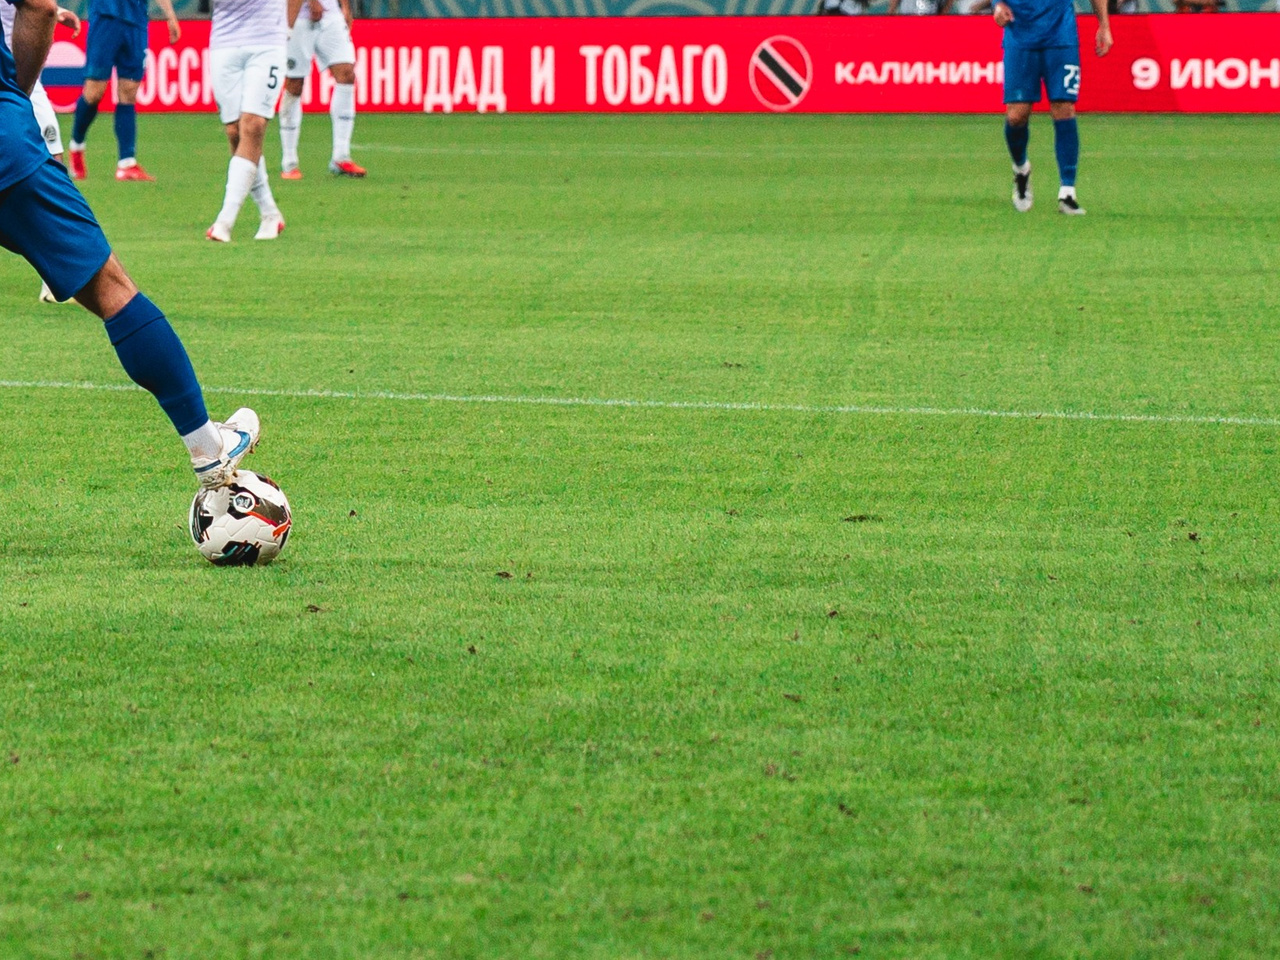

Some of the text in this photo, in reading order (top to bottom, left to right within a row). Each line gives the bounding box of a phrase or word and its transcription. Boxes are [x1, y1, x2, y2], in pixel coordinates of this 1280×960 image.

[267, 65, 279, 90] 5
[530, 45, 555, 105] И
[579, 43, 728, 106] ТОБАГО
[1131, 57, 1160, 91] 9
